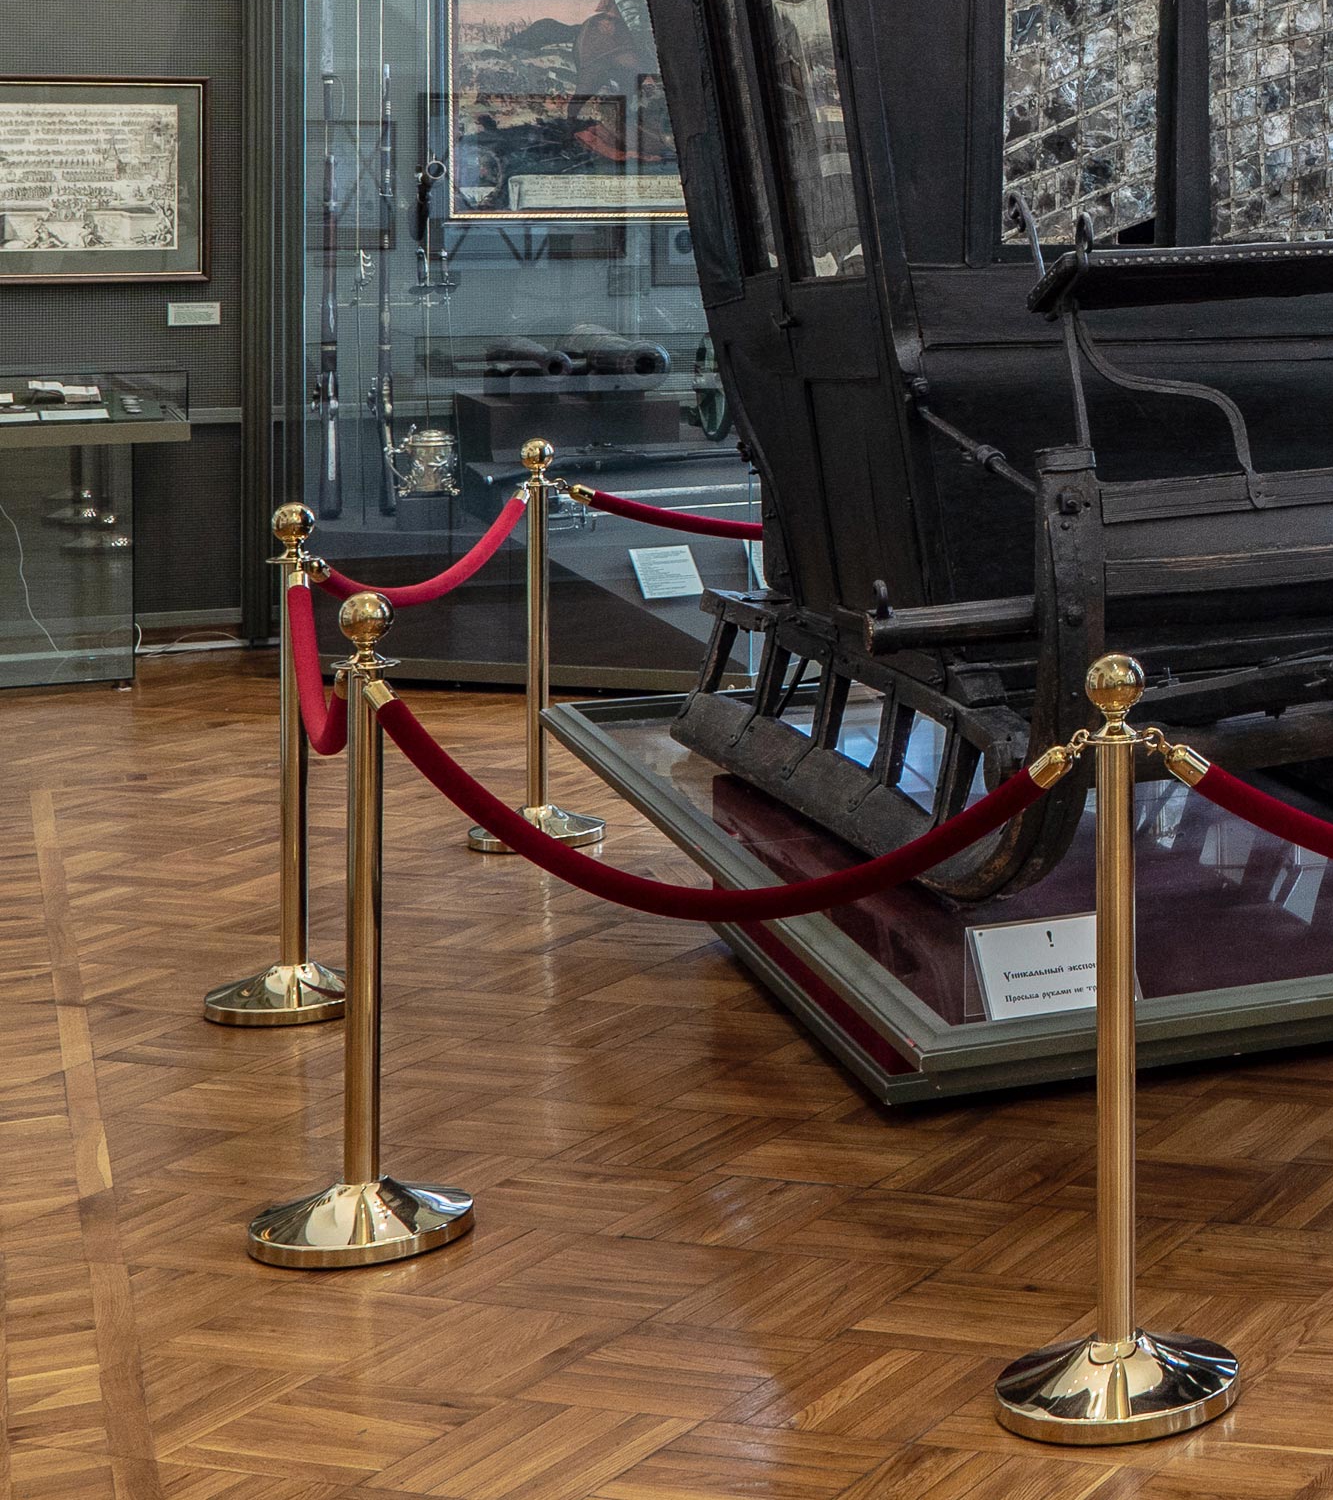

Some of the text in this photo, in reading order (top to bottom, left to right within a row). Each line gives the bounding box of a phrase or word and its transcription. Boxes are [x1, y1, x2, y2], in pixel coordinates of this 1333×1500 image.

[1046, 930, 1054, 947] !
[1003, 965, 1064, 982] Уникальный
[1042, 988, 1071, 1000] руками
